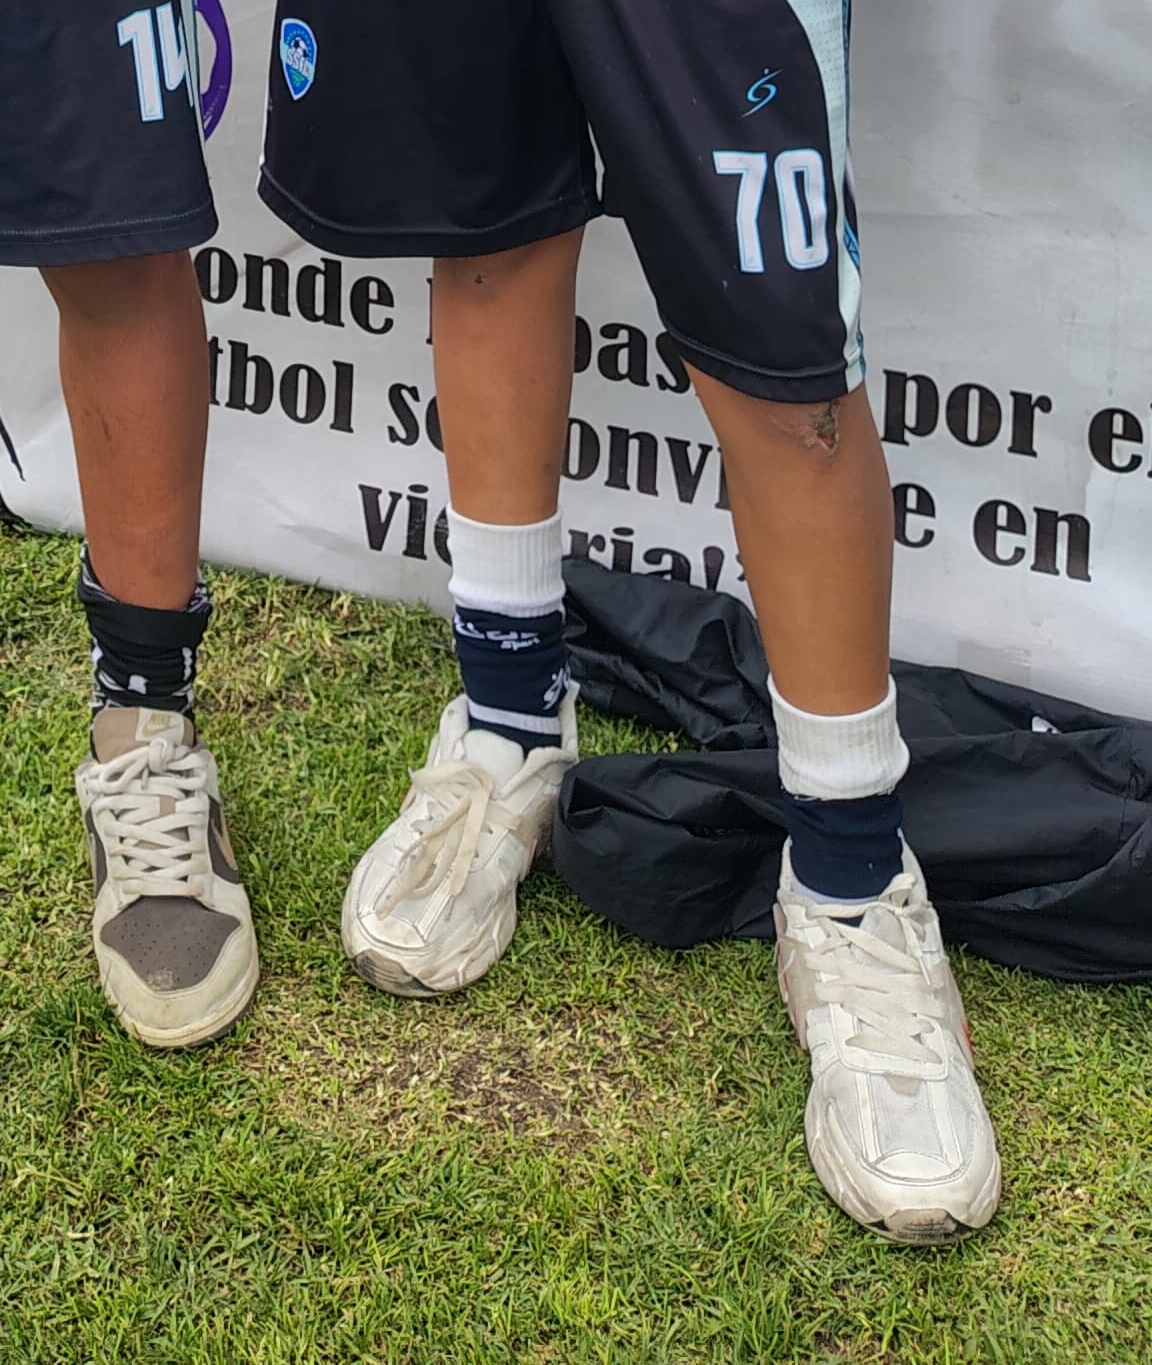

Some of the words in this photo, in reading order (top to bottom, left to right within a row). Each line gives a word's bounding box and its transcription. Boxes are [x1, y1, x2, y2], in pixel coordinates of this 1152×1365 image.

[712, 148, 830, 273] 70
[193, 245, 395, 336] onde
[880, 369, 1054, 457] por
[1087, 404, 1152, 480] e
[208, 334, 355, 434] tbol
[973, 499, 1092, 583] en
